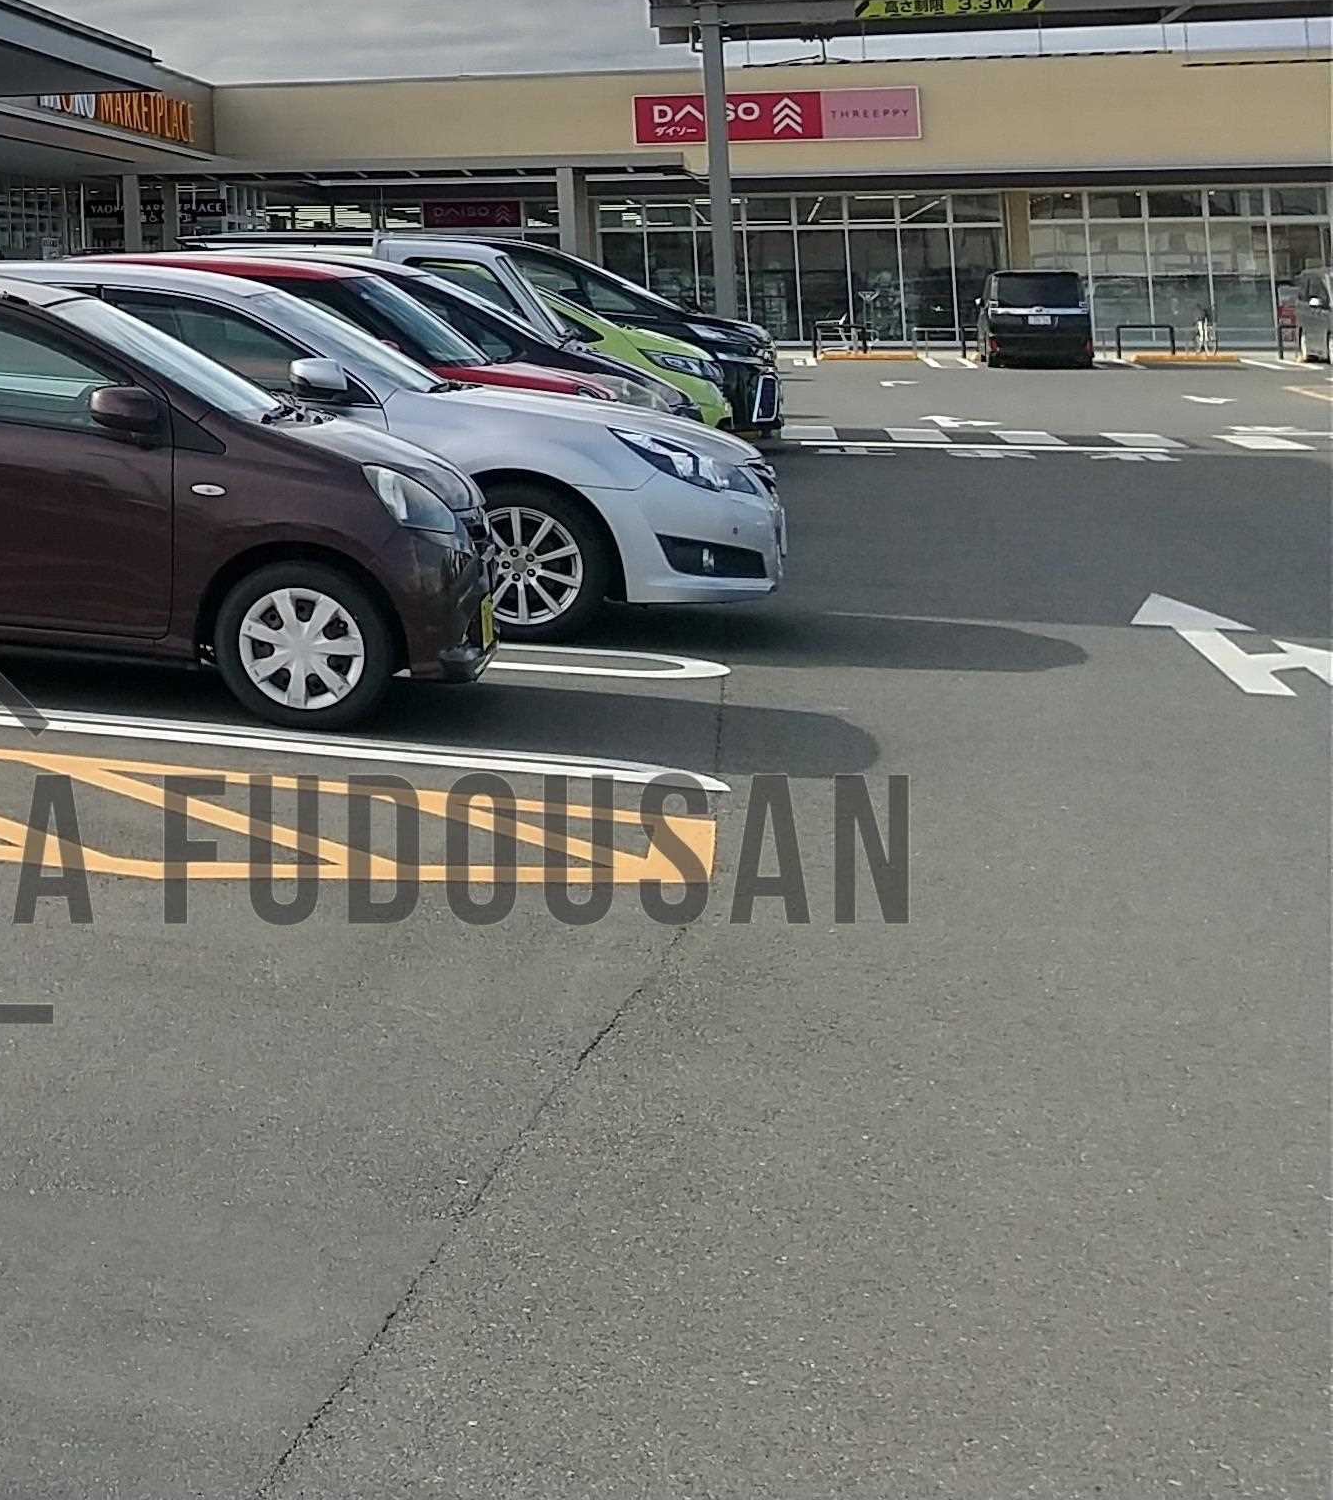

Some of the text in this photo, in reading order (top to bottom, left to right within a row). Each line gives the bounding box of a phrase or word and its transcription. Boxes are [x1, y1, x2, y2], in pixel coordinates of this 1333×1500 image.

[100, 91, 196, 143] MARKETPLACE
[652, 102, 760, 124] DASO
[830, 108, 910, 119] THREEPPY
[654, 126, 697, 137] ダイソー
[90, 203, 124, 215] YAO
